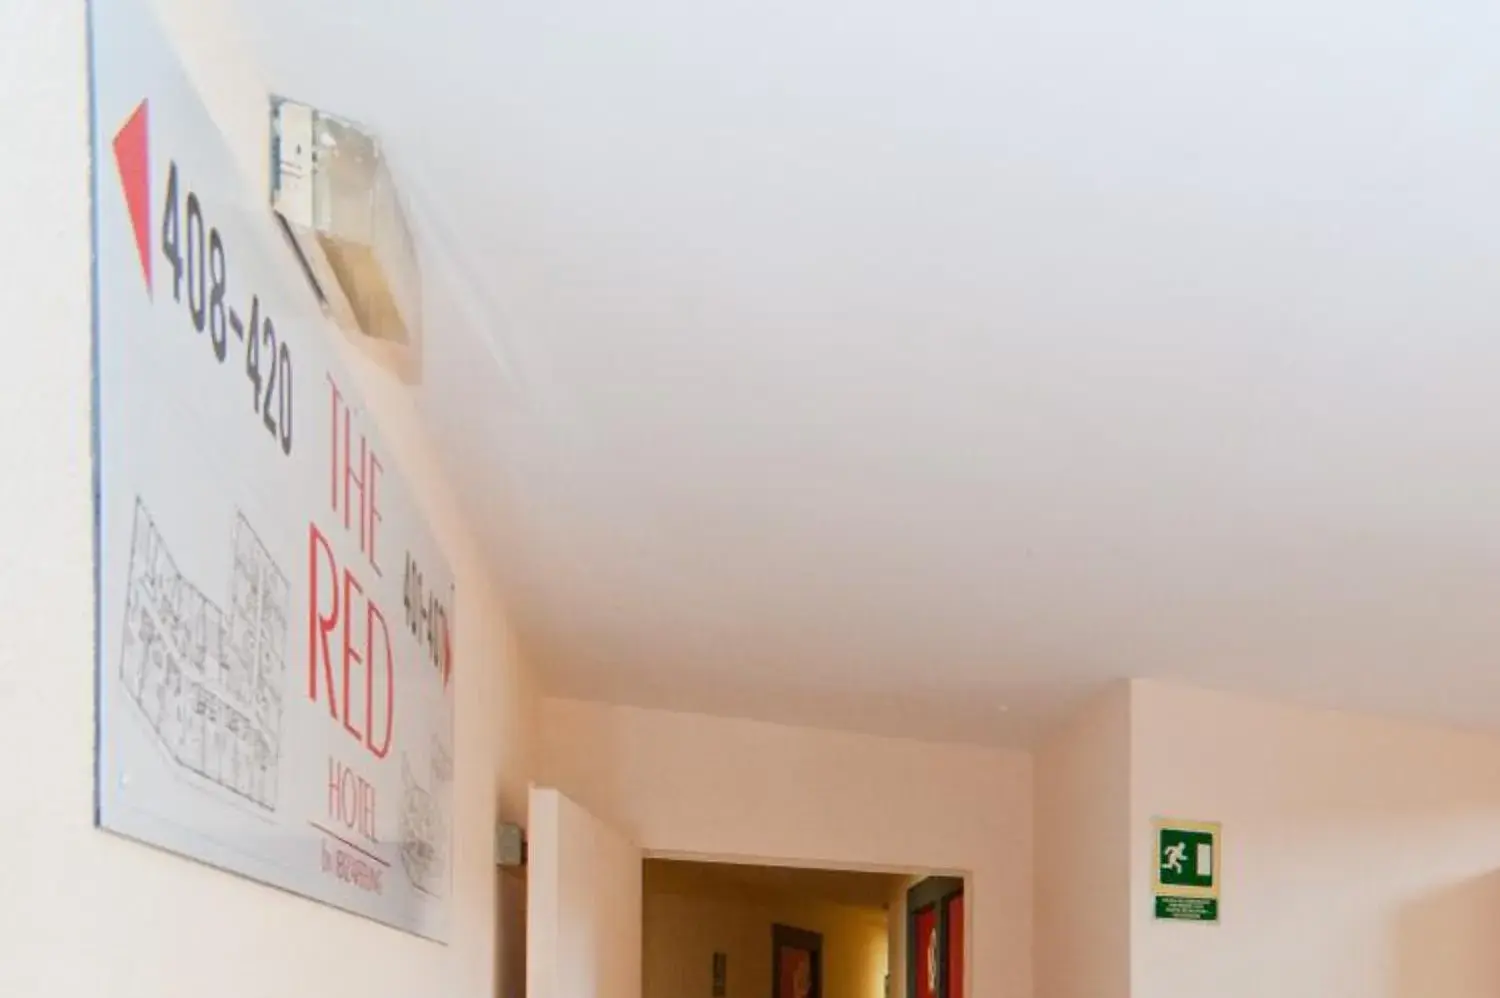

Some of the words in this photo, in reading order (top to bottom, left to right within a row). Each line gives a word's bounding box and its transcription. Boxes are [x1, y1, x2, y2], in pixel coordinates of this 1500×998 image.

[161, 158, 294, 456] 408-420
[326, 371, 384, 578] THE
[307, 521, 395, 759] RED
[328, 754, 379, 844] HOTEL
